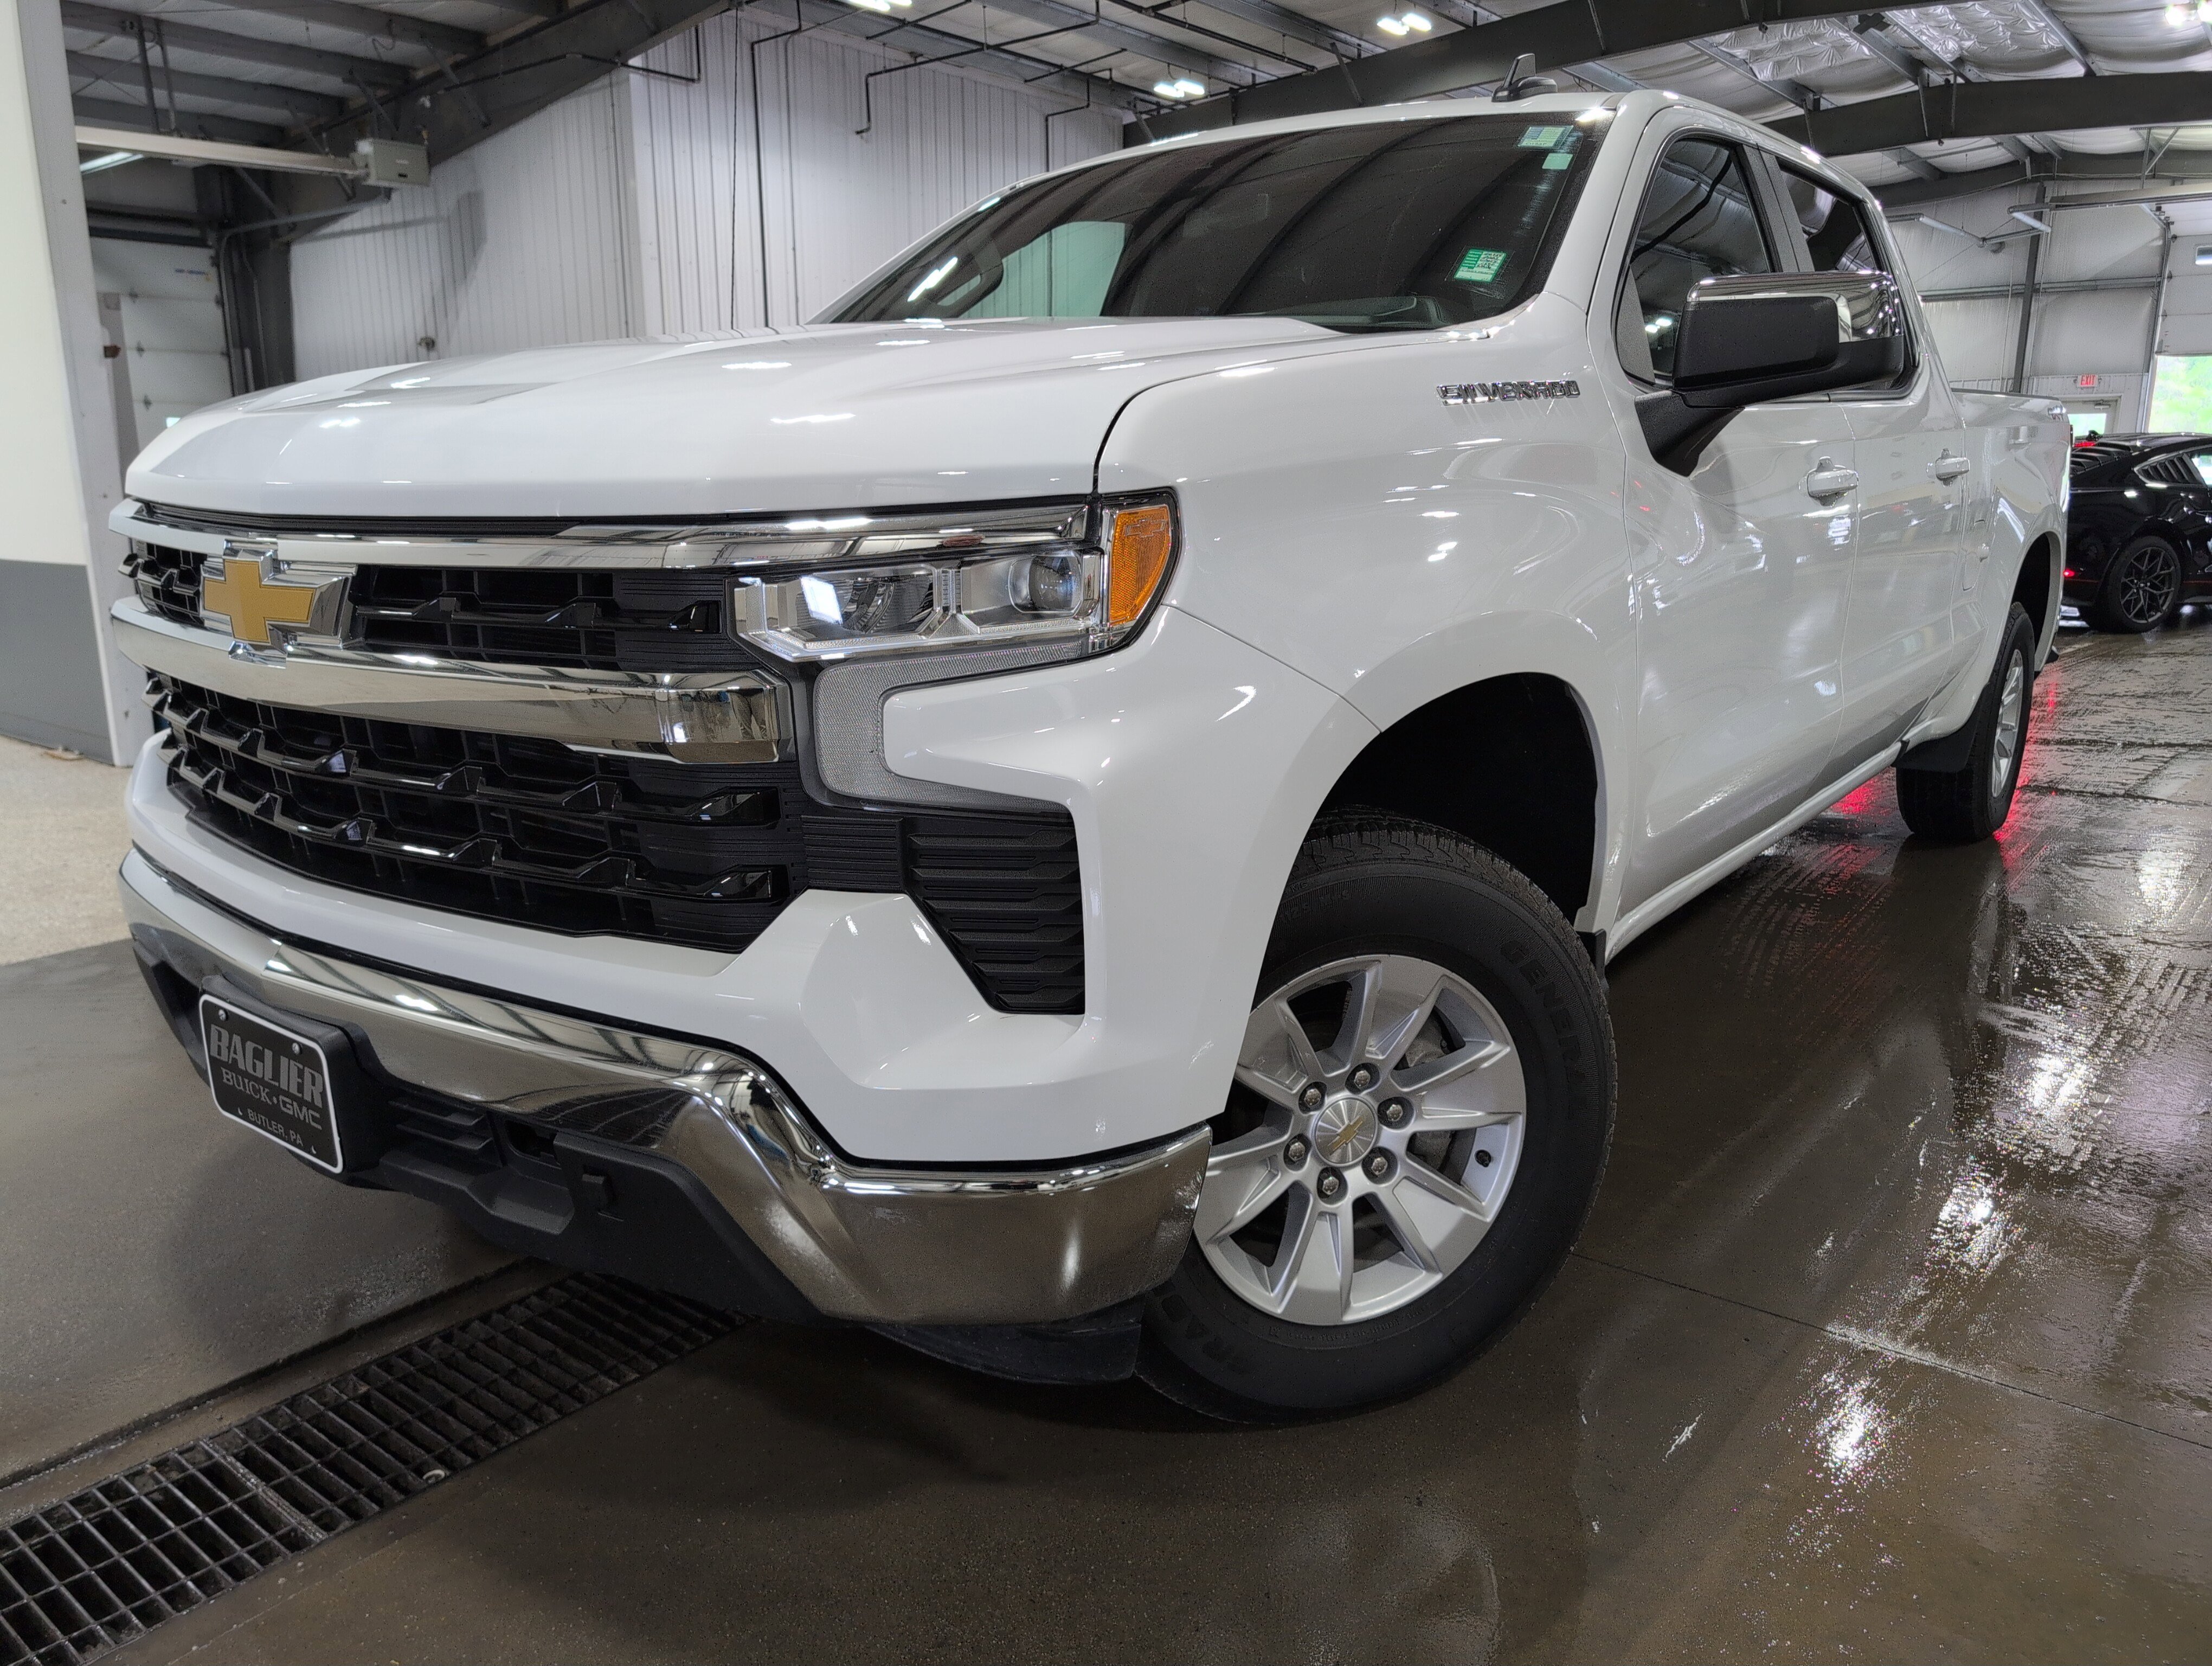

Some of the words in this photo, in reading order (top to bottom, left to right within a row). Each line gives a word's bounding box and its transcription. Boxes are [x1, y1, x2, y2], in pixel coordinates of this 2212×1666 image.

[1437, 380, 1580, 406] SILVERADO
[2081, 375, 2095, 386] EXIT
[1500, 939, 1587, 1120] GENERAL
[209, 1023, 324, 1108] BAGLIER
[290, 1128, 304, 1148] PA
